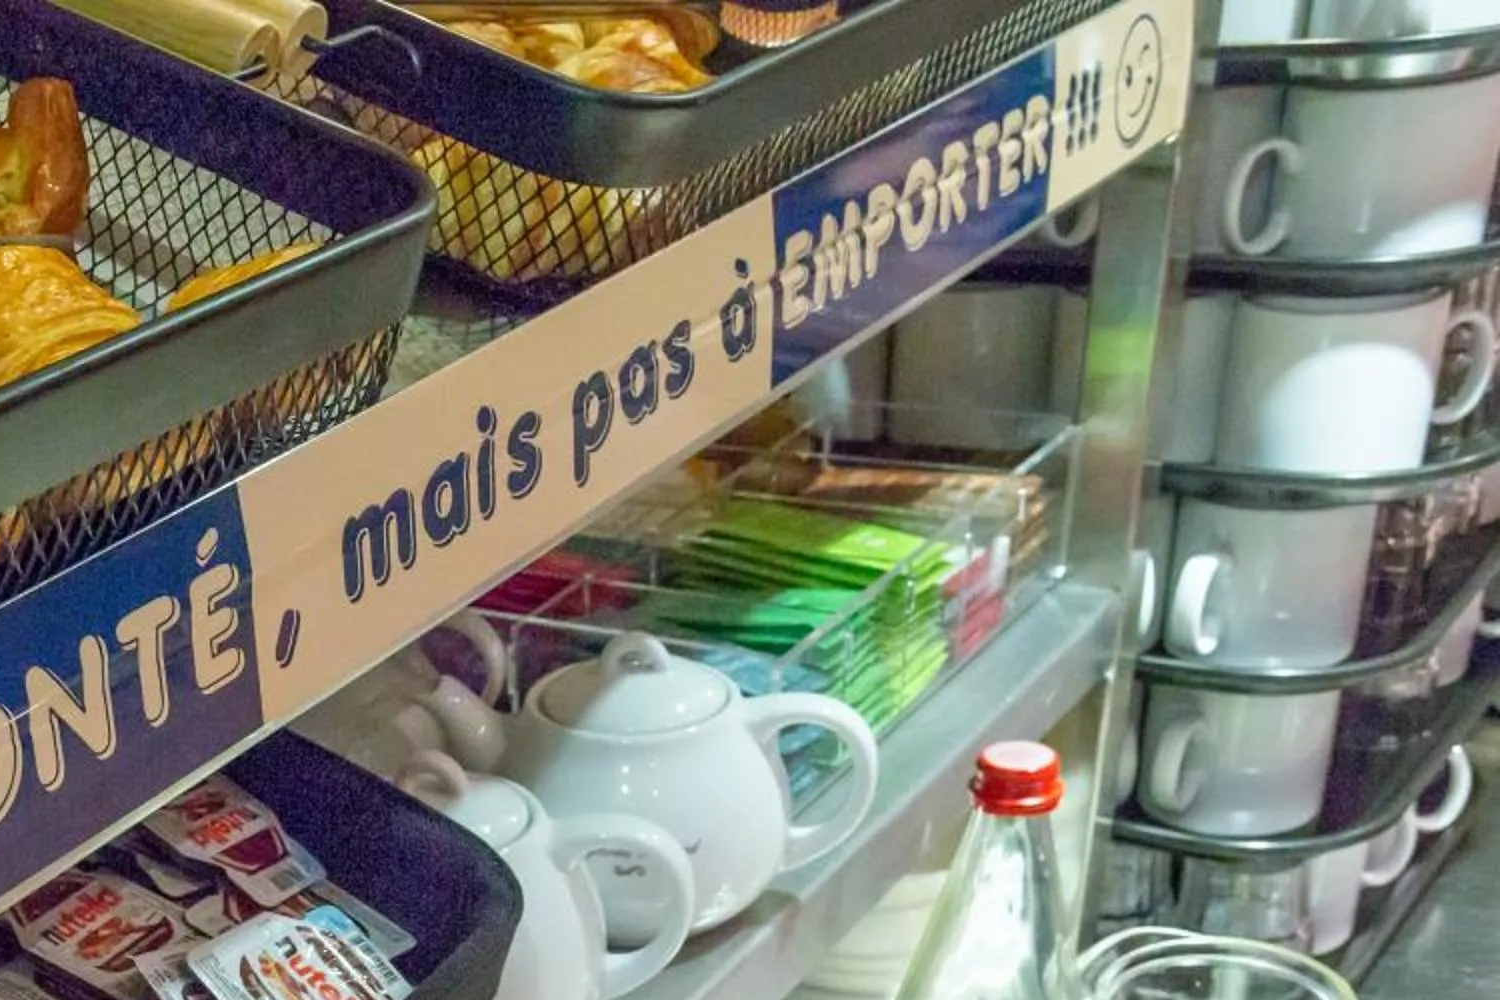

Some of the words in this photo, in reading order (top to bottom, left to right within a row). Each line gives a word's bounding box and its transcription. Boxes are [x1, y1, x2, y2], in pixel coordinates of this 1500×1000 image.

[342, 404, 543, 600] mais
[571, 319, 694, 487] pas
[720, 258, 758, 362] à
[780, 95, 1051, 329] EMPORTER
[41, 884, 125, 946] nutella
